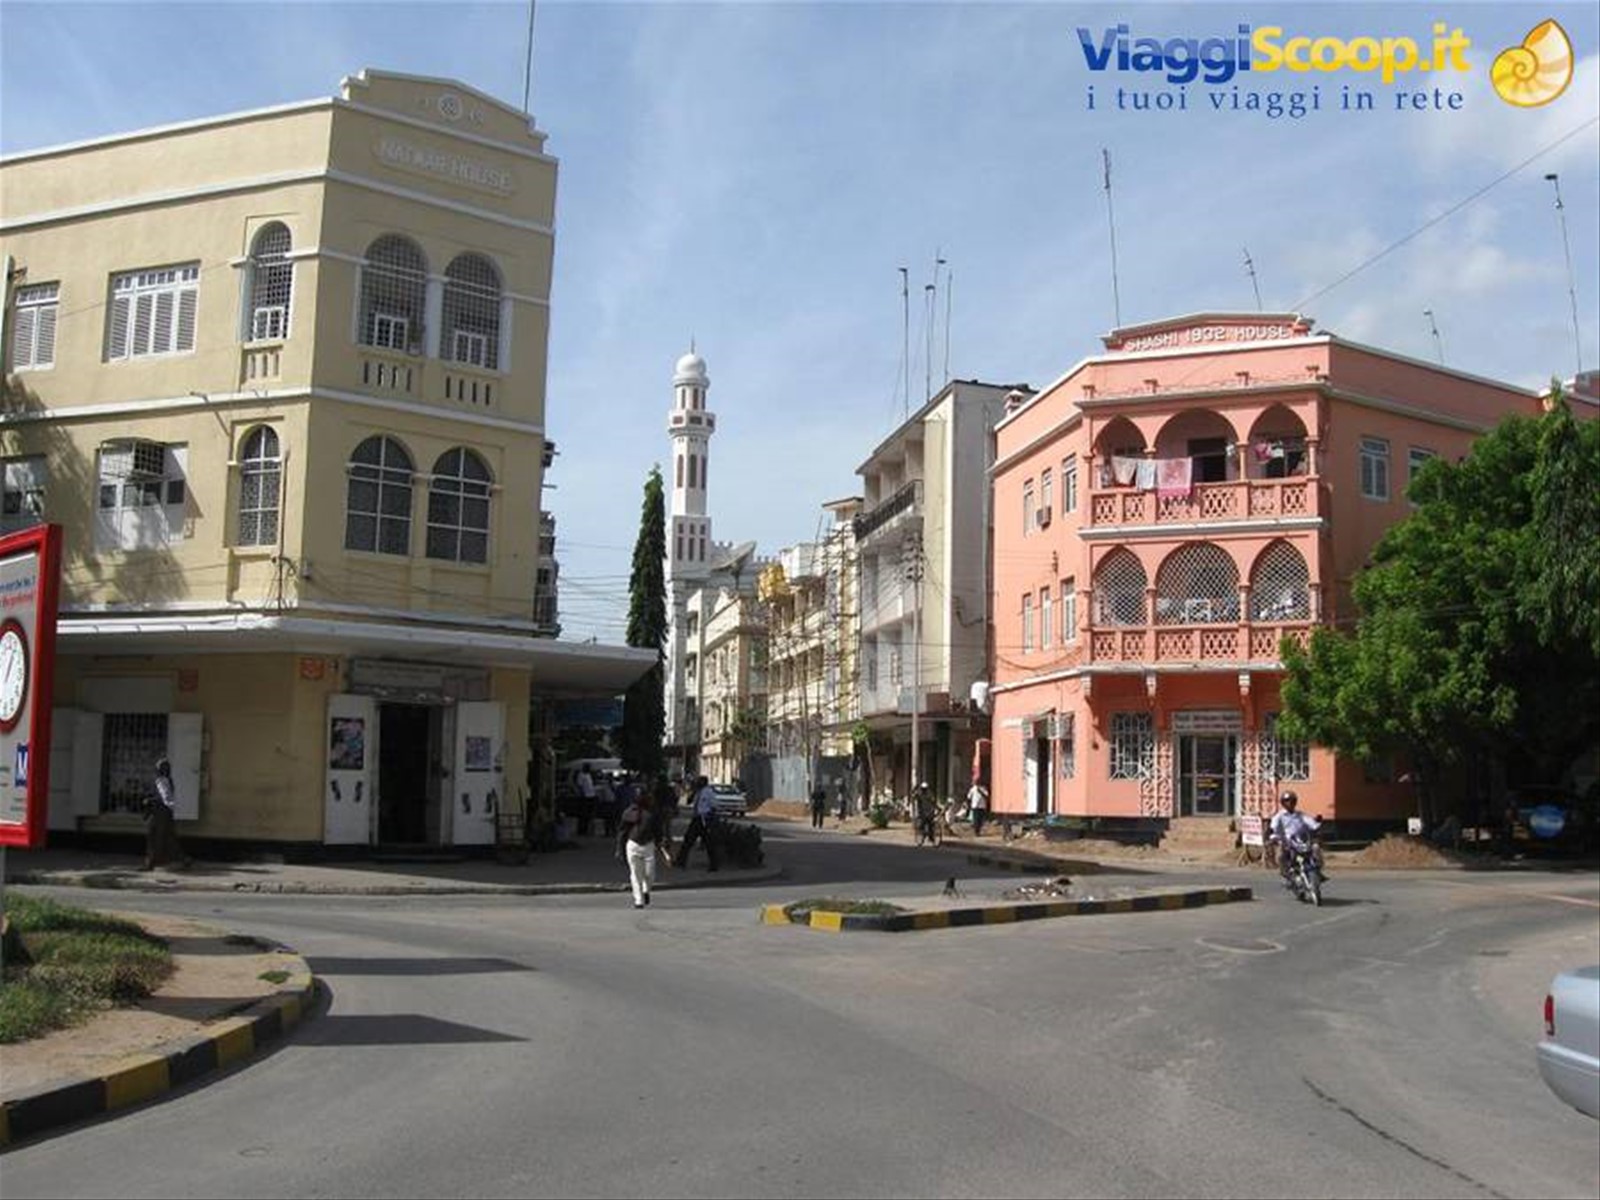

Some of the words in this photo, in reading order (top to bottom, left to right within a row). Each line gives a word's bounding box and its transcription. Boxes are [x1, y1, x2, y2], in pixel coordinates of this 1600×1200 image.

[1123, 332, 1179, 351] SHASHI
[1186, 326, 1226, 343] 1932
[1235, 325, 1290, 341] HOUSE
